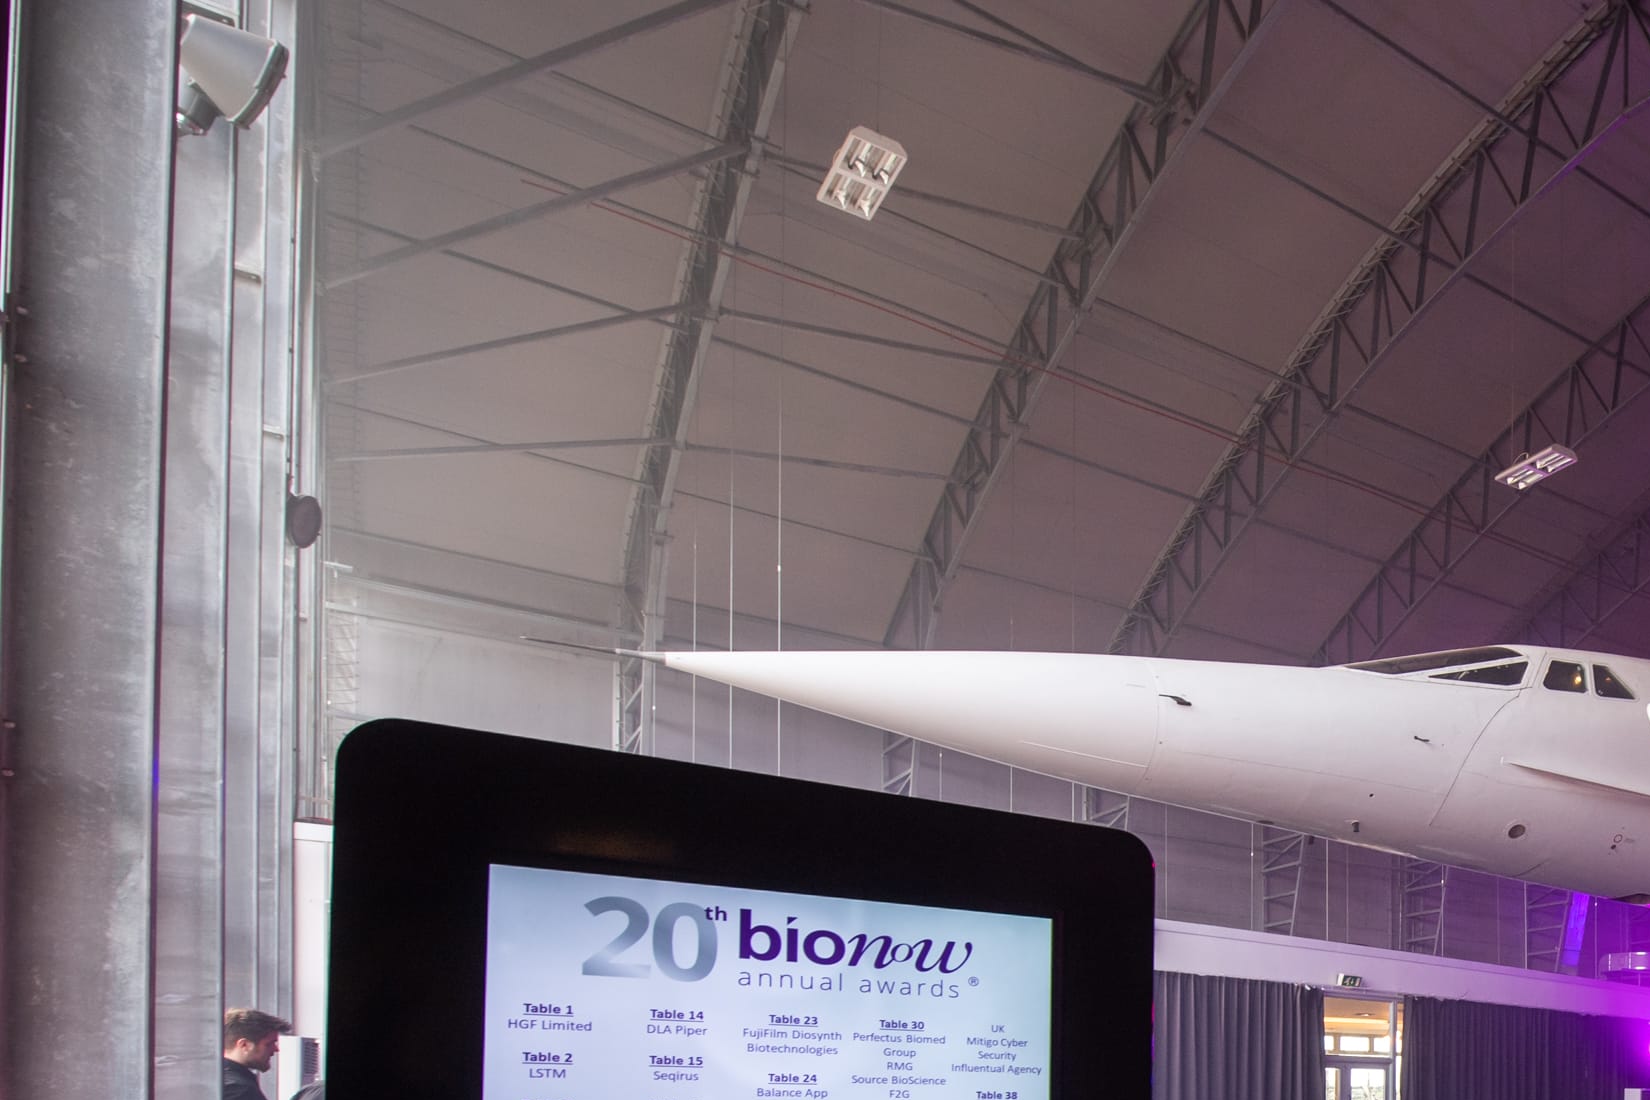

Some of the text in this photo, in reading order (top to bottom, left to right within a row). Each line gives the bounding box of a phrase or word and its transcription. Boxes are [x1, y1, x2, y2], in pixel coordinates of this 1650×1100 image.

[739, 908, 973, 974] bionow
[738, 971, 843, 992] annual
[523, 1002, 574, 1015] Table 1
[649, 1008, 704, 1021] Table 14
[507, 1018, 593, 1032] HGF Limited
[768, 1014, 818, 1026] Table 23
[646, 1023, 708, 1038] DLA Piper
[742, 1027, 843, 1042] FujiFilm Diosynth
[852, 1032, 946, 1045] Perfectus Biomed
[747, 1042, 839, 1057] Biotechnologies
[882, 1047, 917, 1060] Group
[522, 1051, 573, 1063] Table 2
[529, 1067, 567, 1079] LSTM
[886, 1061, 914, 1072] RMG
[1006, 1064, 1042, 1077] Agency
[653, 1070, 700, 1083] Seqirus
[851, 1074, 947, 1086] Source BioScience
[756, 1087, 828, 1100] Balance App
[889, 1089, 910, 1099] F2G
[975, 1090, 1018, 1100] Table 38
